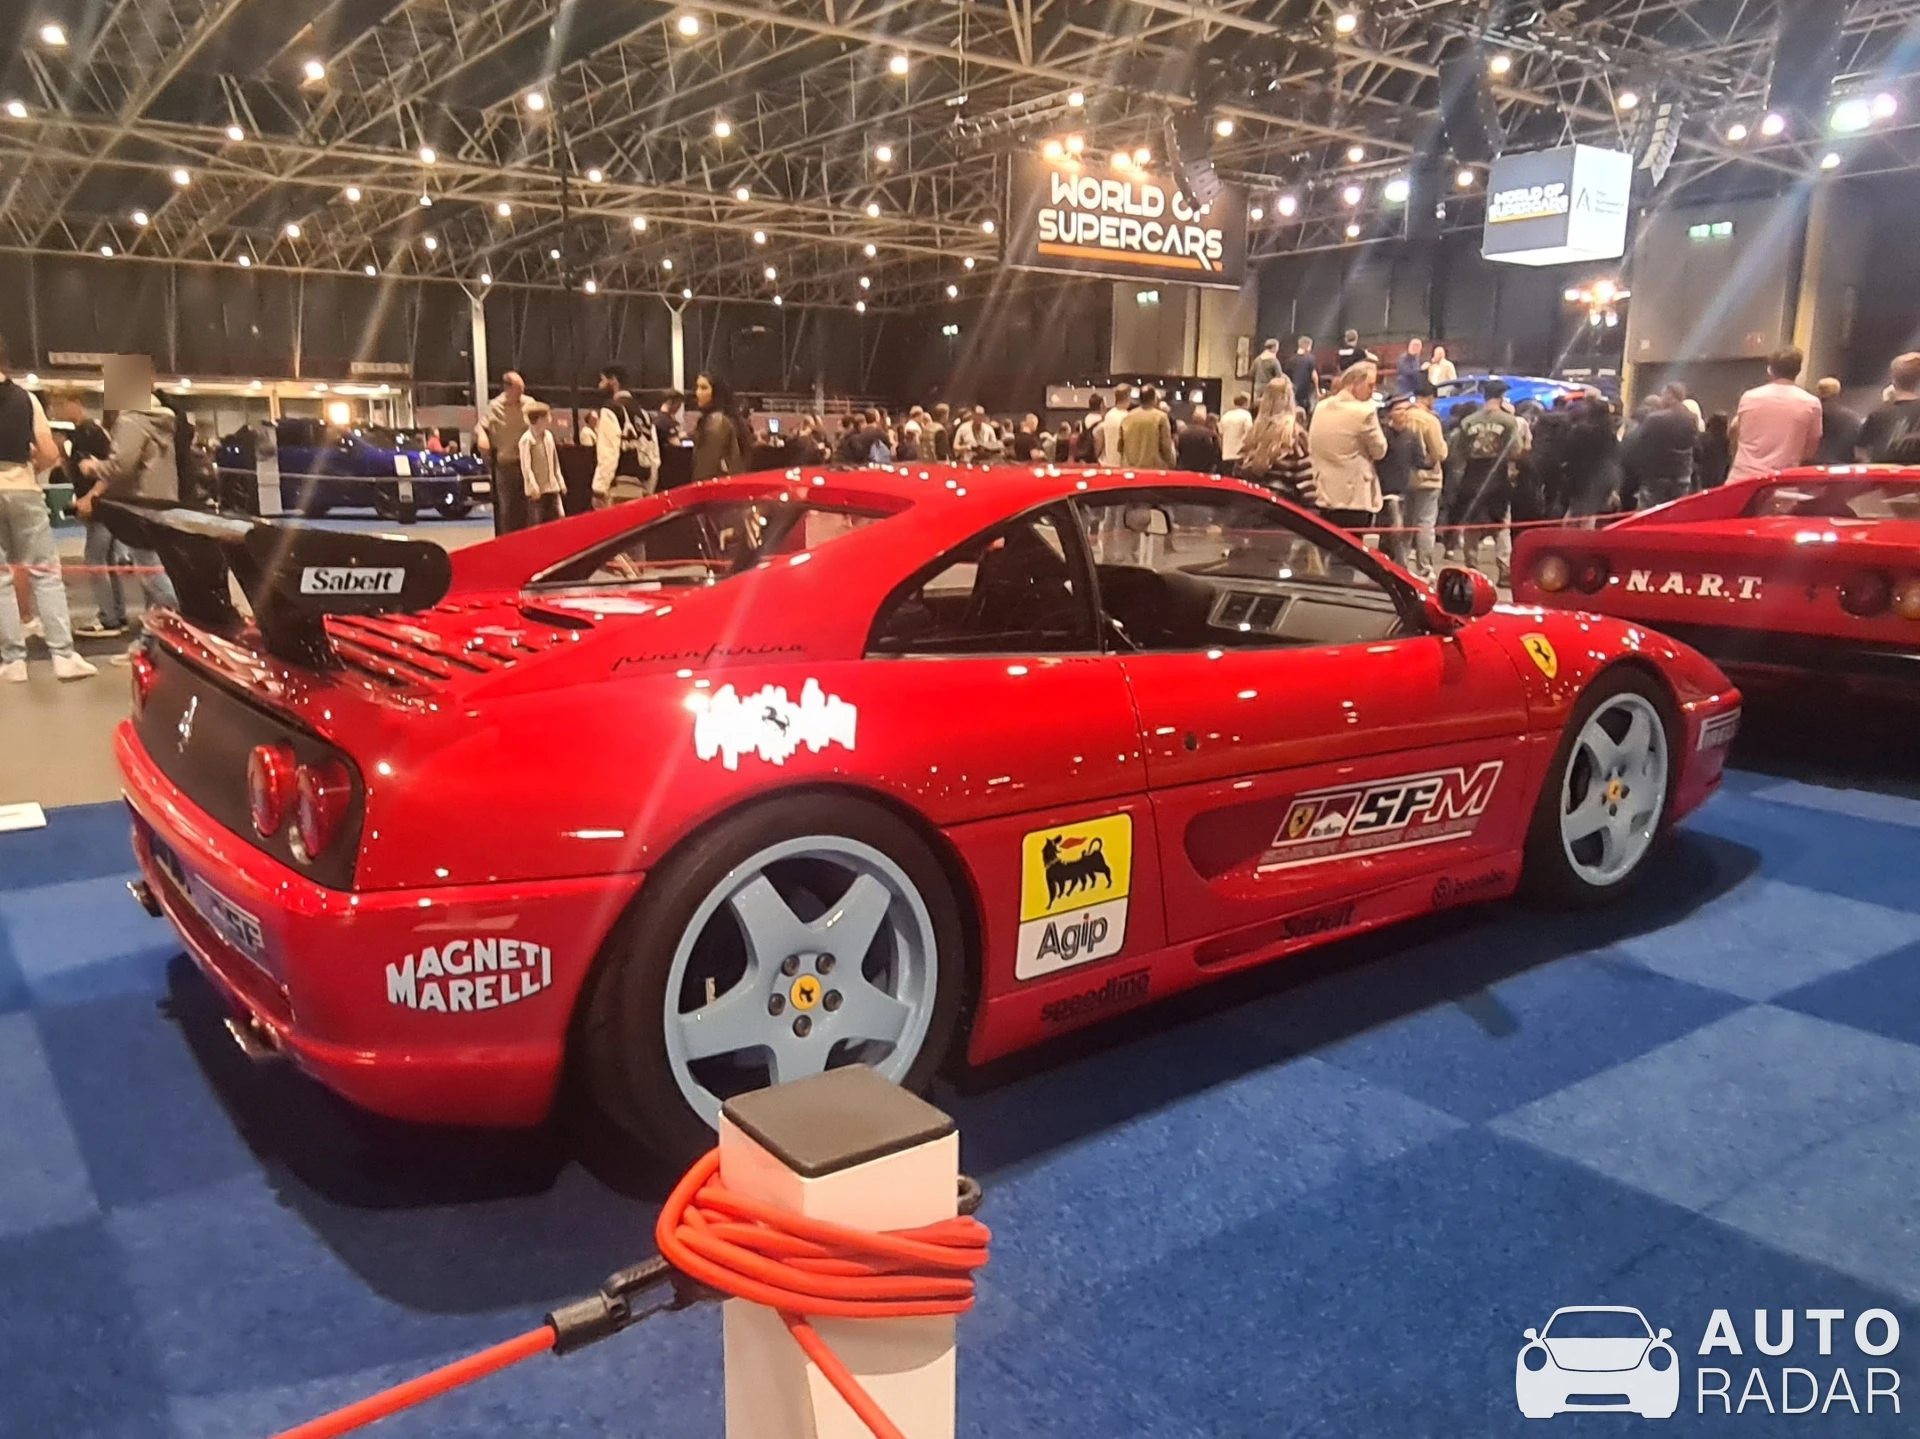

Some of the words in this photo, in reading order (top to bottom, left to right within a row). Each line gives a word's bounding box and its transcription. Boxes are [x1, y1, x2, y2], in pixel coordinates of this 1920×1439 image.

[1051, 171, 1165, 218] WORLD
[1038, 208, 1223, 271] SUPERCARS
[311, 569, 394, 591] Sabelt
[1626, 569, 1762, 600] N.A.R.T.
[611, 642, 807, 672] pininfarina
[1349, 760, 1504, 836] SFM
[1035, 912, 1108, 961] Agip
[386, 938, 552, 995] MAGNETI
[386, 954, 552, 1012] MARELLI
